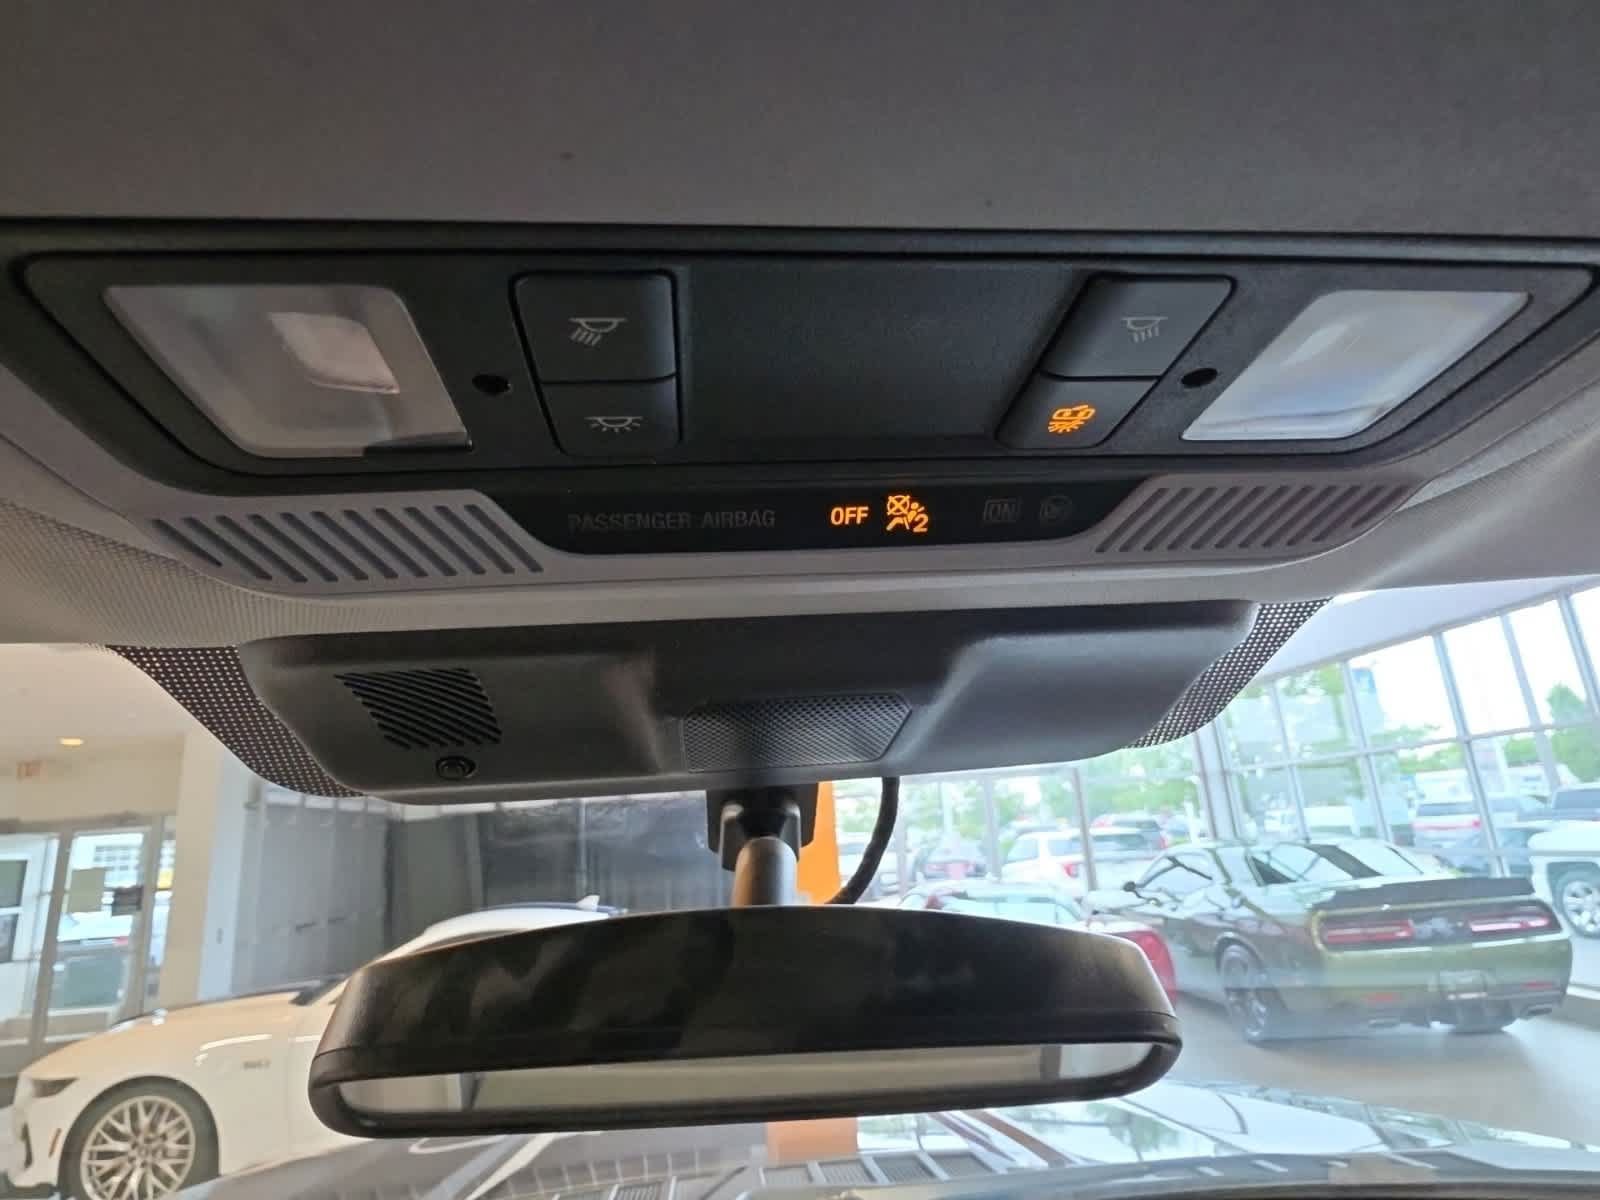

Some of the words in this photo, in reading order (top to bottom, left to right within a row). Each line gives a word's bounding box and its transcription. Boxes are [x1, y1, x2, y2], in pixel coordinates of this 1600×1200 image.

[567, 511, 693, 534] PASSENGER
[702, 509, 777, 530] AIRBAG
[830, 505, 869, 526] OFF
